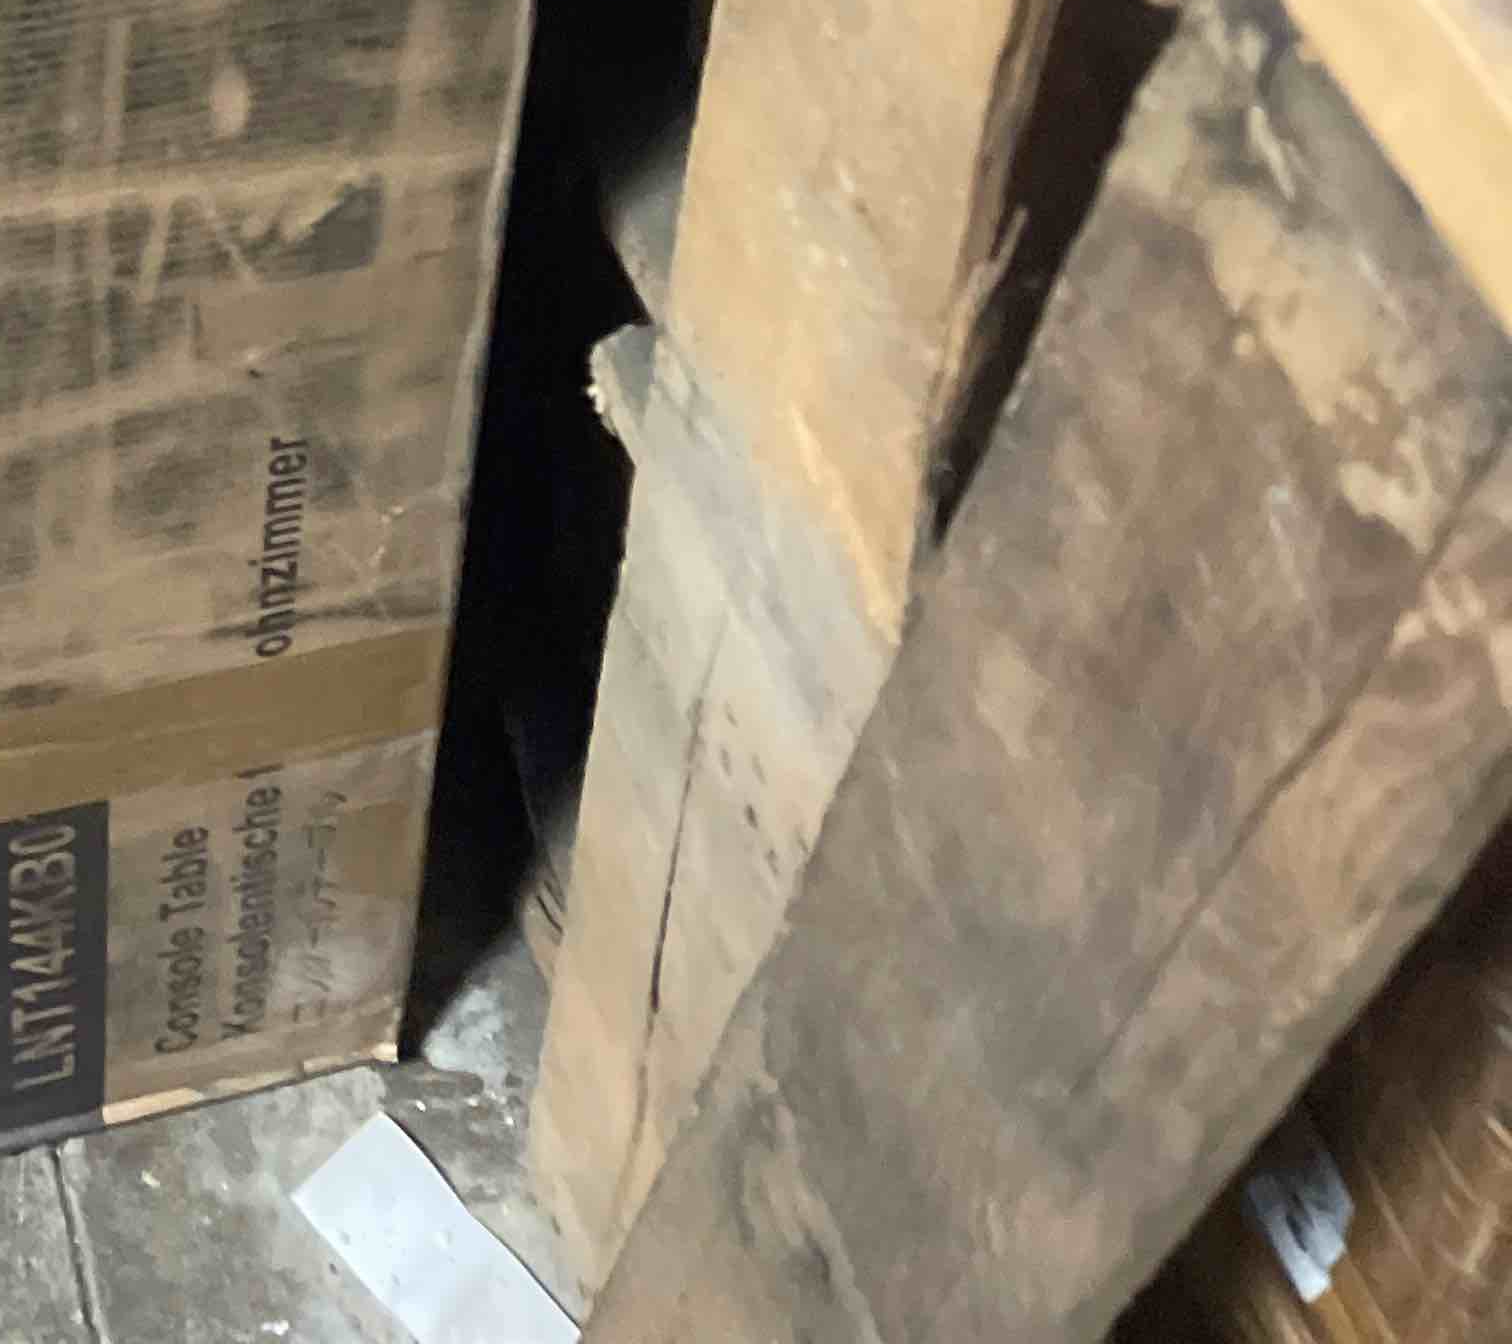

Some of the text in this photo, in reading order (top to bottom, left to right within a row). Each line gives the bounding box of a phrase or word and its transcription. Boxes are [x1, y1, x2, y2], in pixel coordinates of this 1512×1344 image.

[248, 437, 308, 657] ohnzimmer
[10, 824, 77, 1090] LNT144KB0
[154, 826, 208, 1053] Console Table
